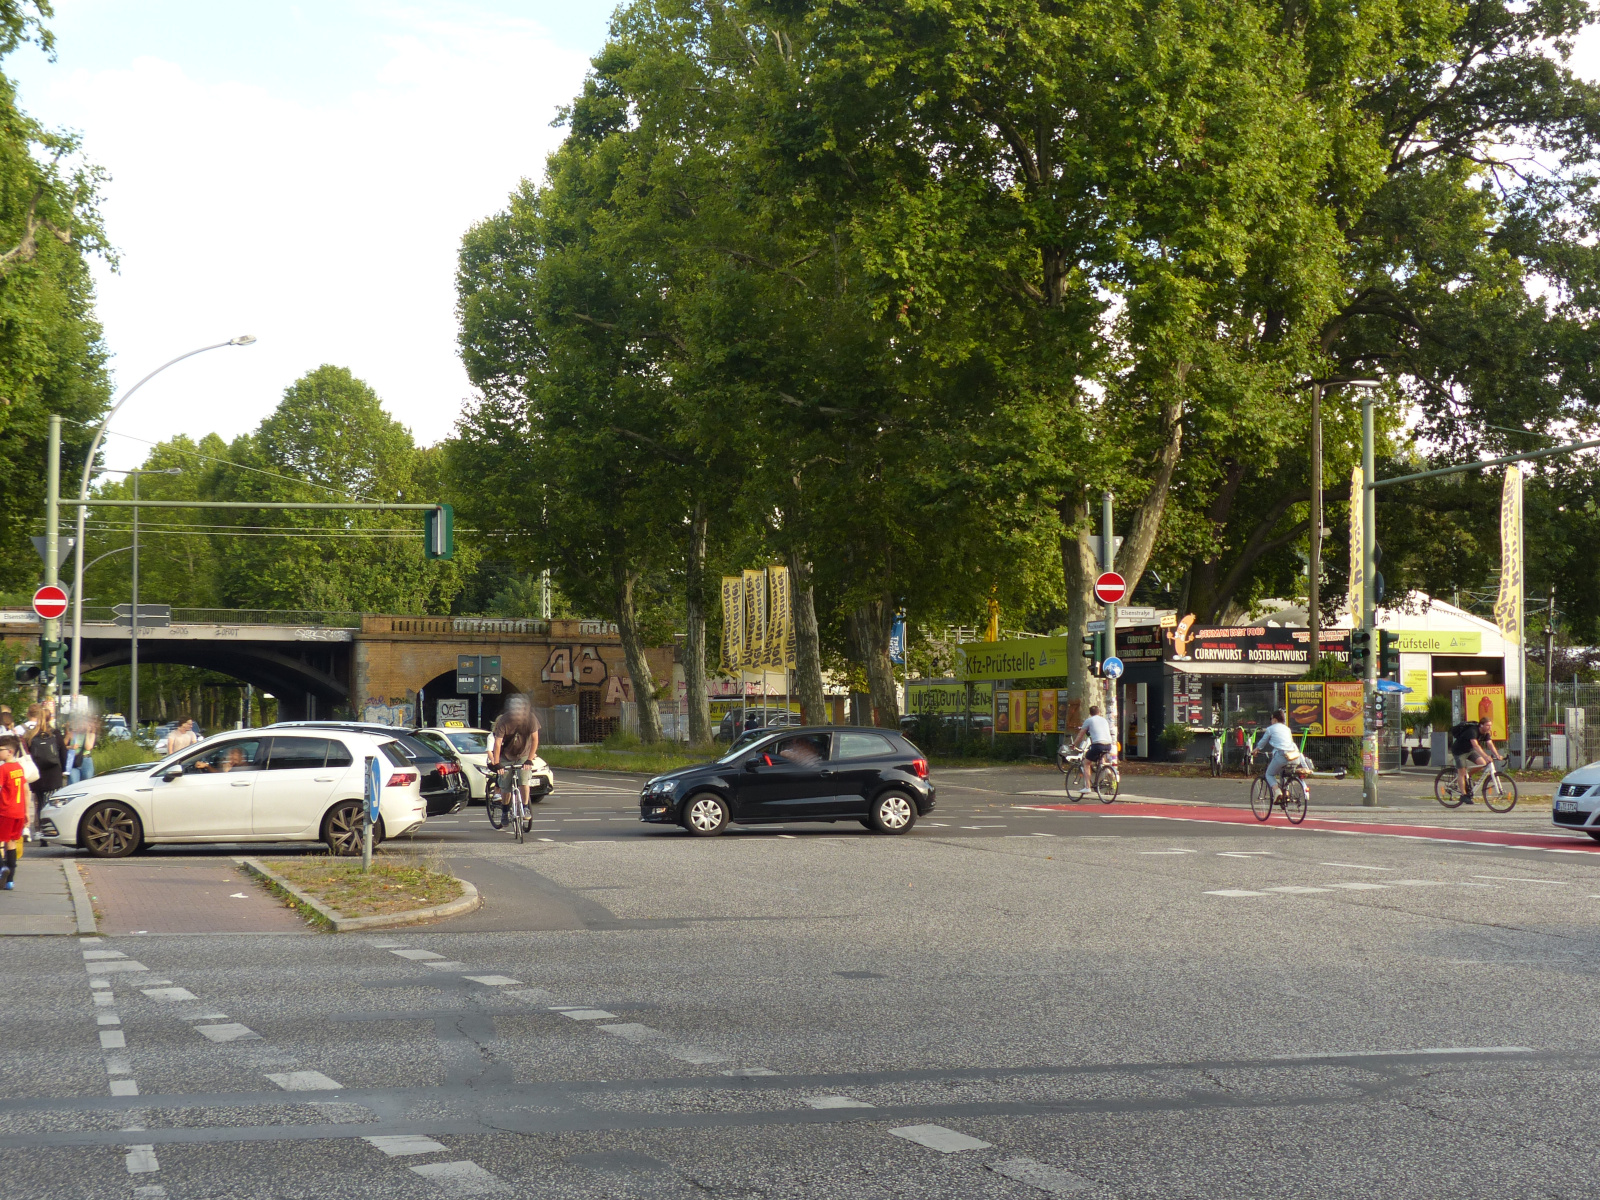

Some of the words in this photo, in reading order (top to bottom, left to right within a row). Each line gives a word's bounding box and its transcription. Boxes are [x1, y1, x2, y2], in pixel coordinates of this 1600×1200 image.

[966, 651, 1036, 675] Kfz-Prüfstelle
[1195, 648, 1242, 660] CURRYWURST
[1248, 650, 1307, 662] ROSTBRATWURST
[541, 646, 608, 688] 46
[1467, 687, 1504, 695] KETTWURST
[1335, 725, 1357, 733] 5,50€
[14, 777, 21, 804] 7
